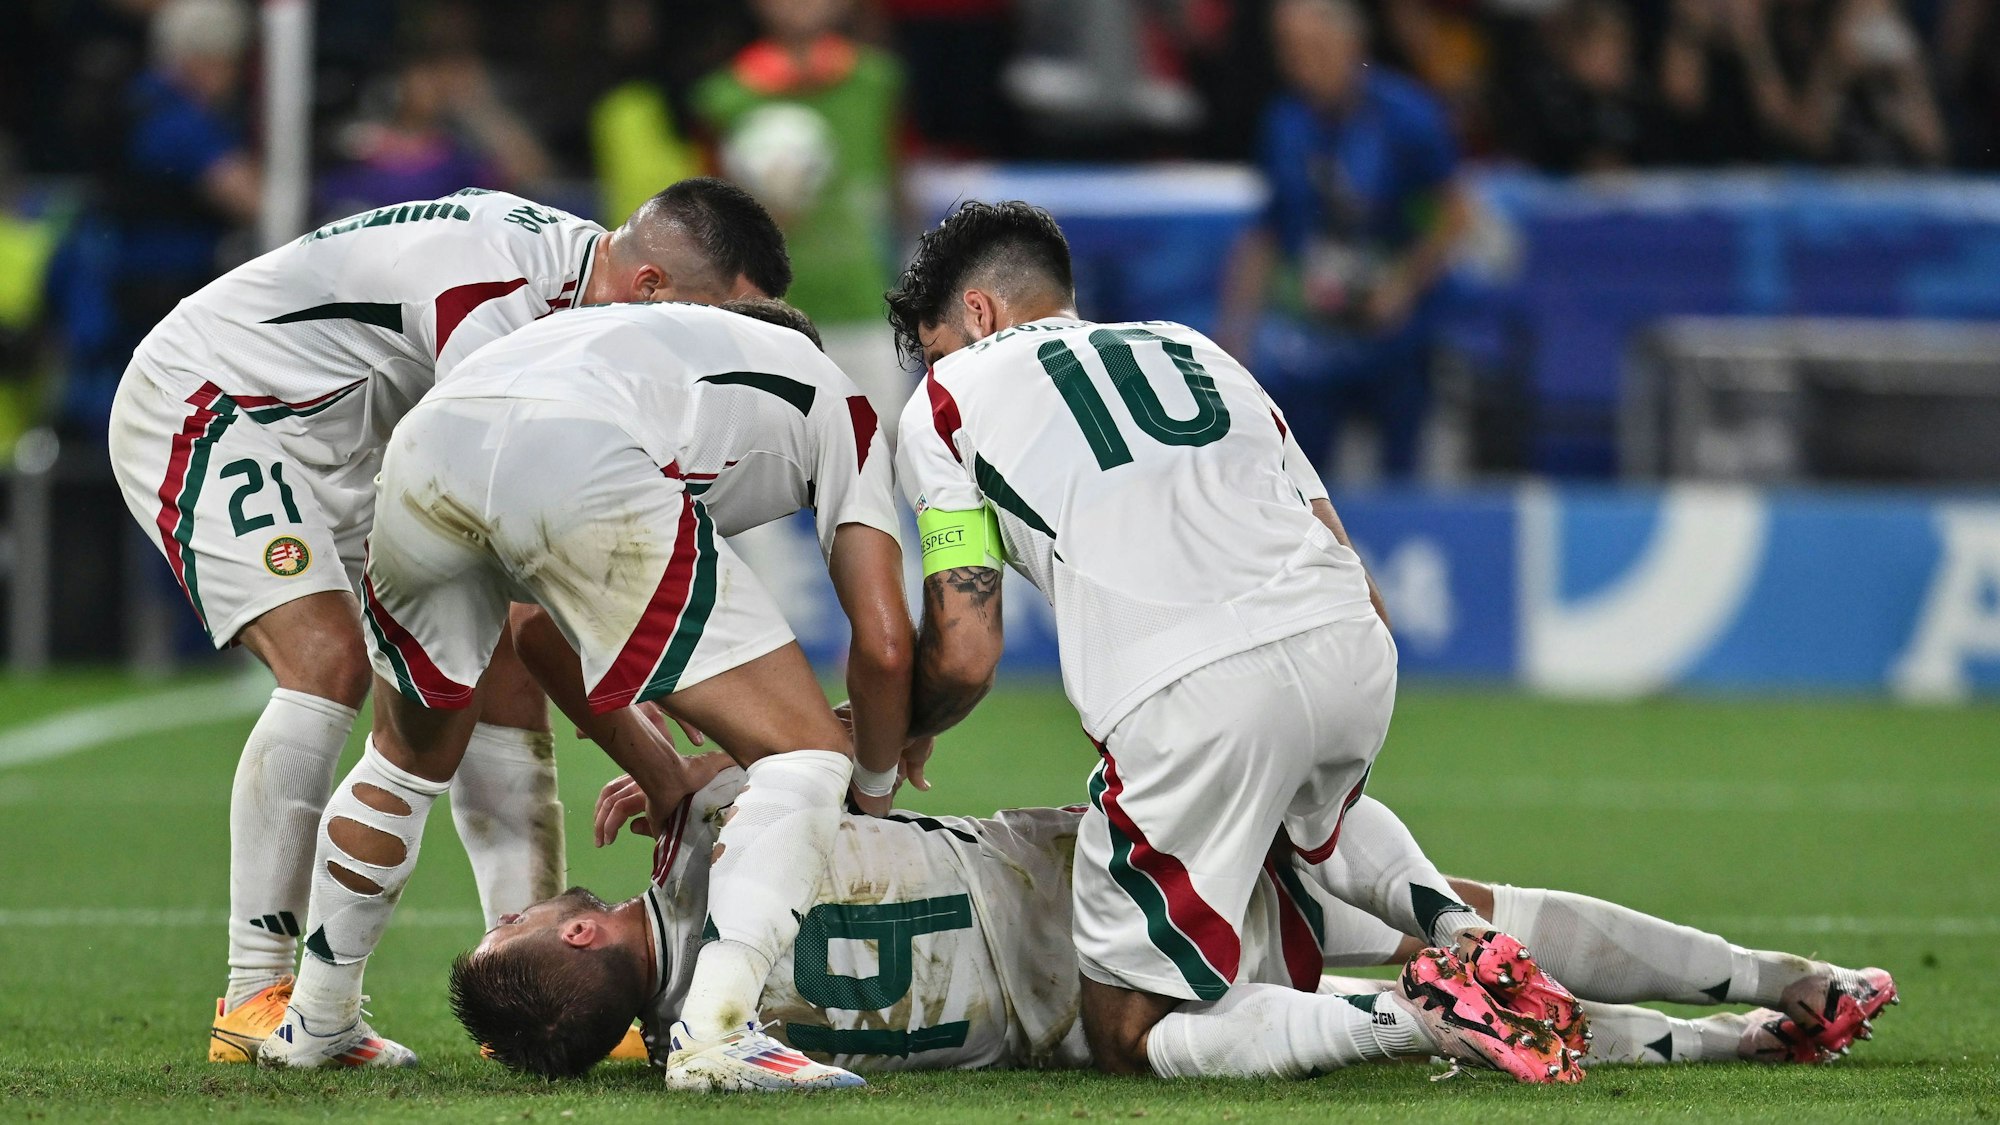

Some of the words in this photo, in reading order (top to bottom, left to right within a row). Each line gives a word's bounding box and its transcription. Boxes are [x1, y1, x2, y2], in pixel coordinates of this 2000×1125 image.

[1037, 328, 1231, 472] 10
[219, 458, 303, 538] 21
[921, 529, 965, 554] ESPECT
[786, 893, 973, 1061] 19
